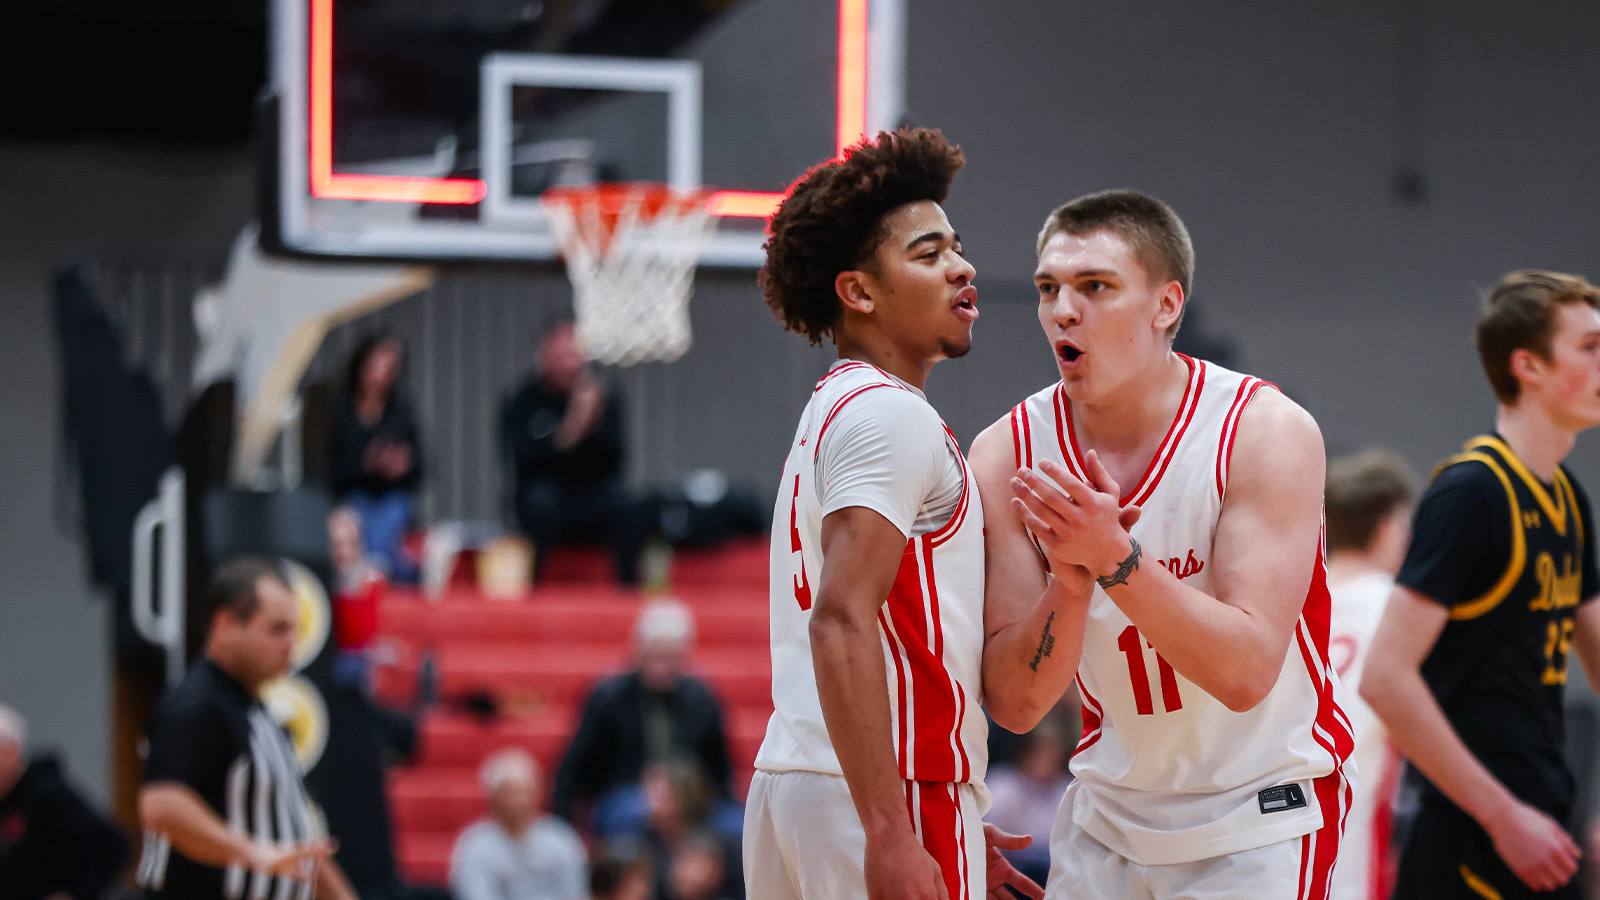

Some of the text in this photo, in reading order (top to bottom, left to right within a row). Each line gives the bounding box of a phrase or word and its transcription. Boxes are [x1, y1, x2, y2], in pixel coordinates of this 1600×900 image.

[790, 473, 812, 612] 5
[1118, 625, 1183, 715] 11
[1290, 791, 1298, 801] L
